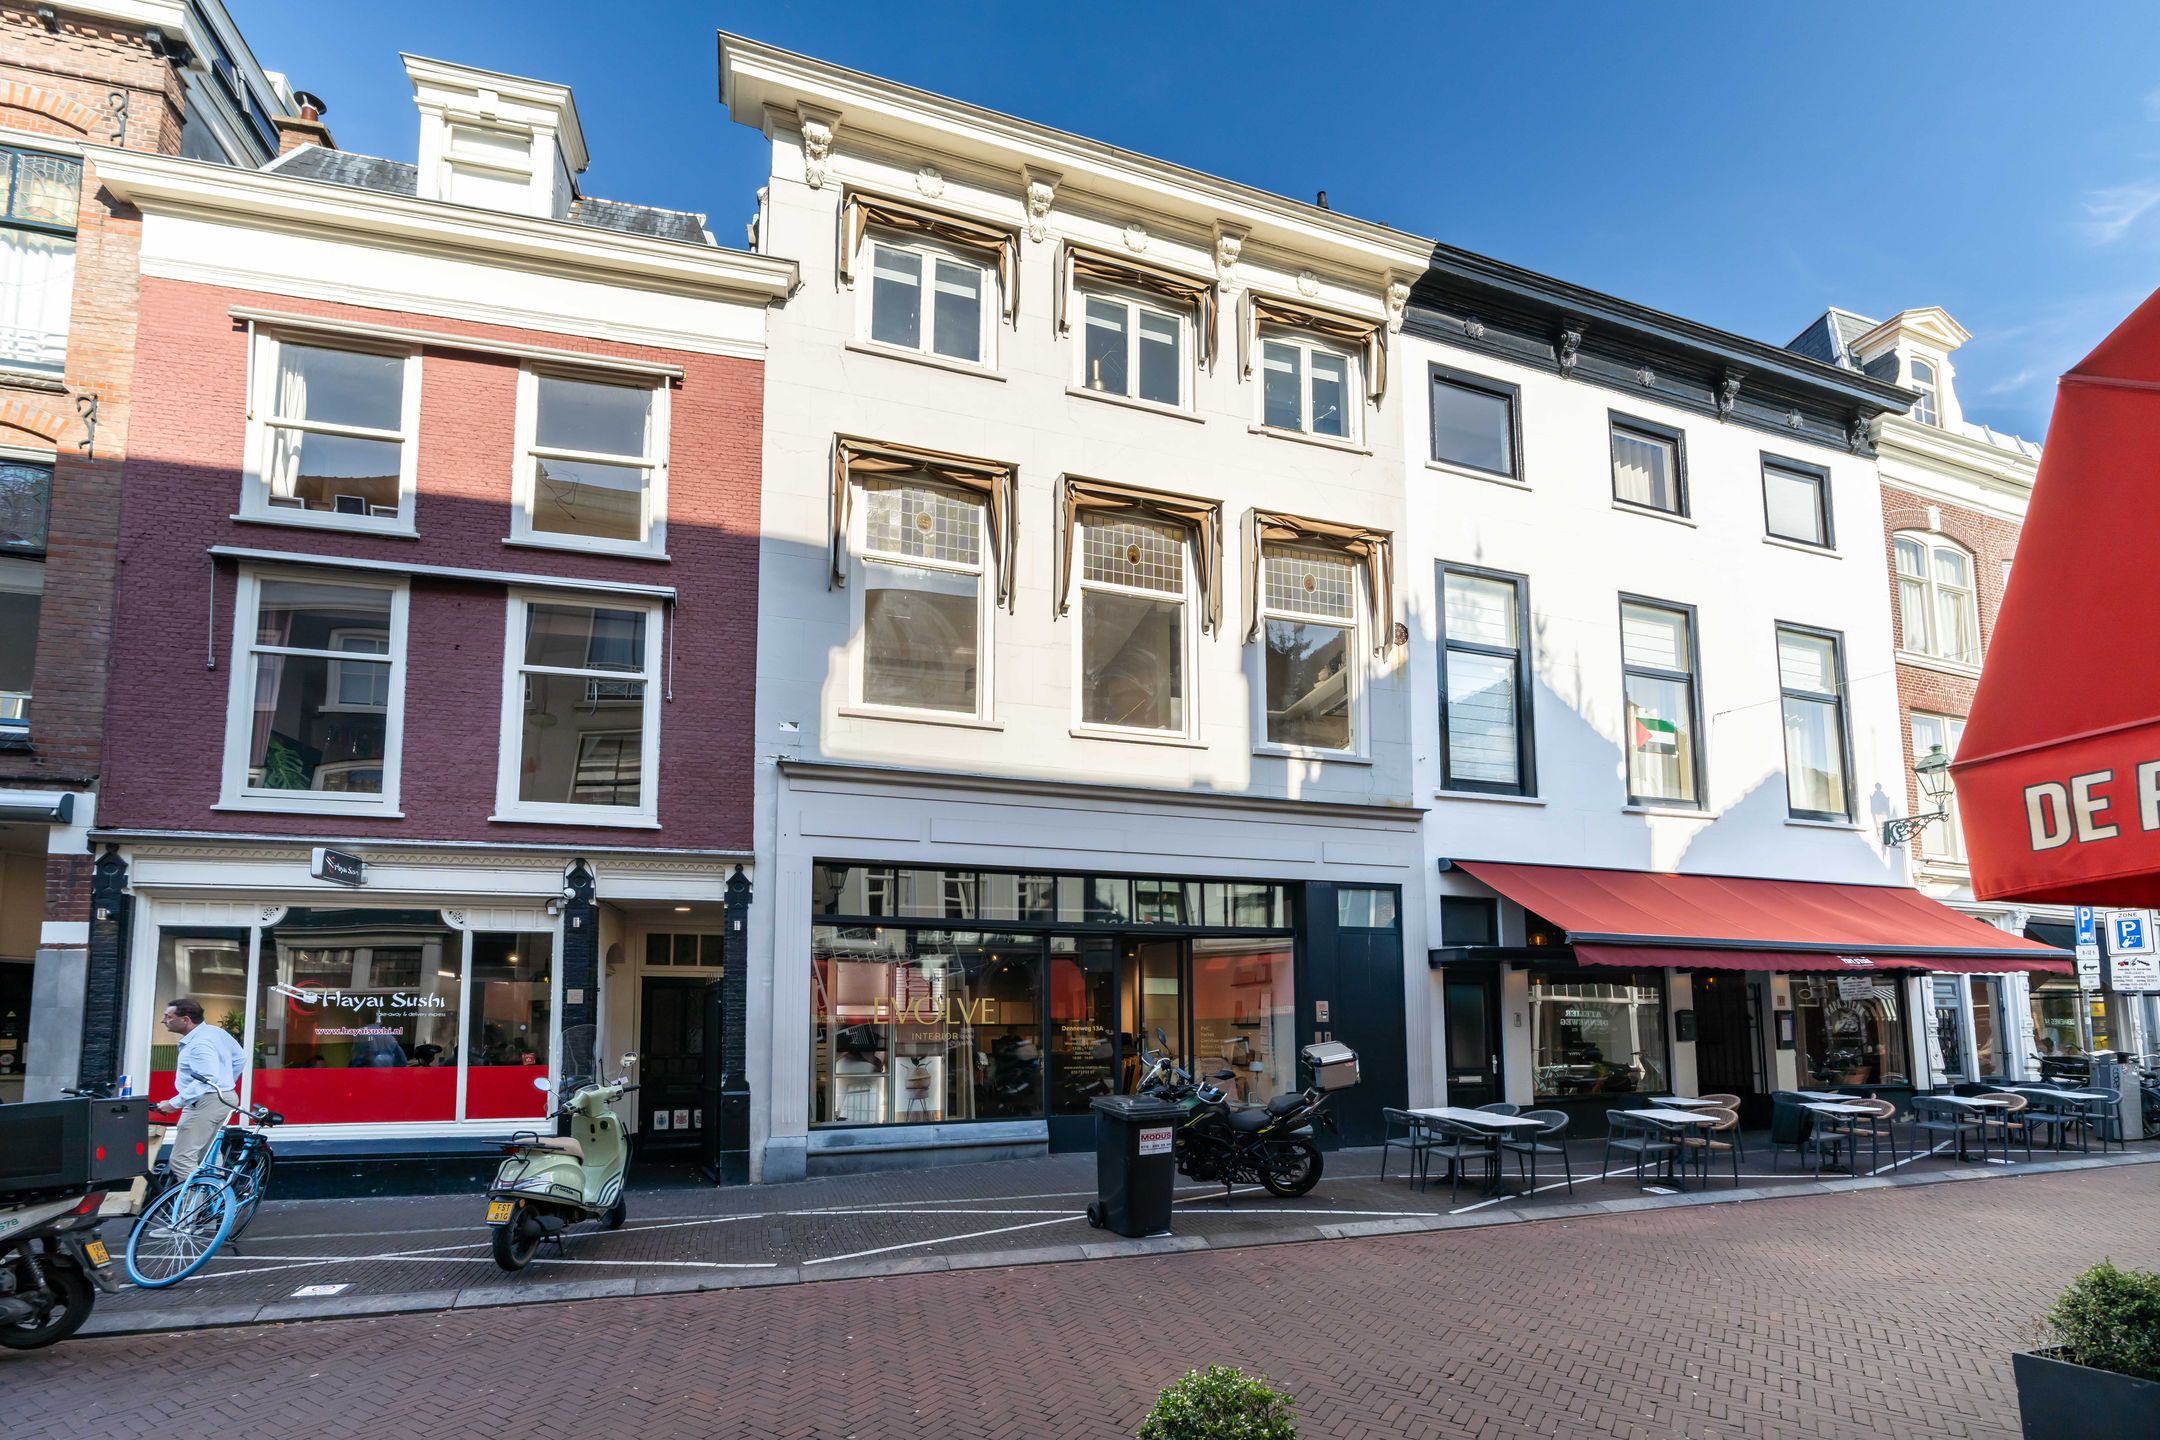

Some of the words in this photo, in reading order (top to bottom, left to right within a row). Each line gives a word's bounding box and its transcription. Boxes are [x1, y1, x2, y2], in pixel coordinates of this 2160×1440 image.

[2023, 769, 2120, 852] DE
[317, 991, 384, 1012] Hayai
[391, 992, 446, 1008] Sushi
[873, 997, 996, 1025] EVOLVE
[315, 1026, 404, 1036] www.hayaisushi.nl
[911, 1032, 959, 1040] INTERIOR
[1141, 1132, 1171, 1142] MODUS
[496, 1204, 511, 1212] FST
